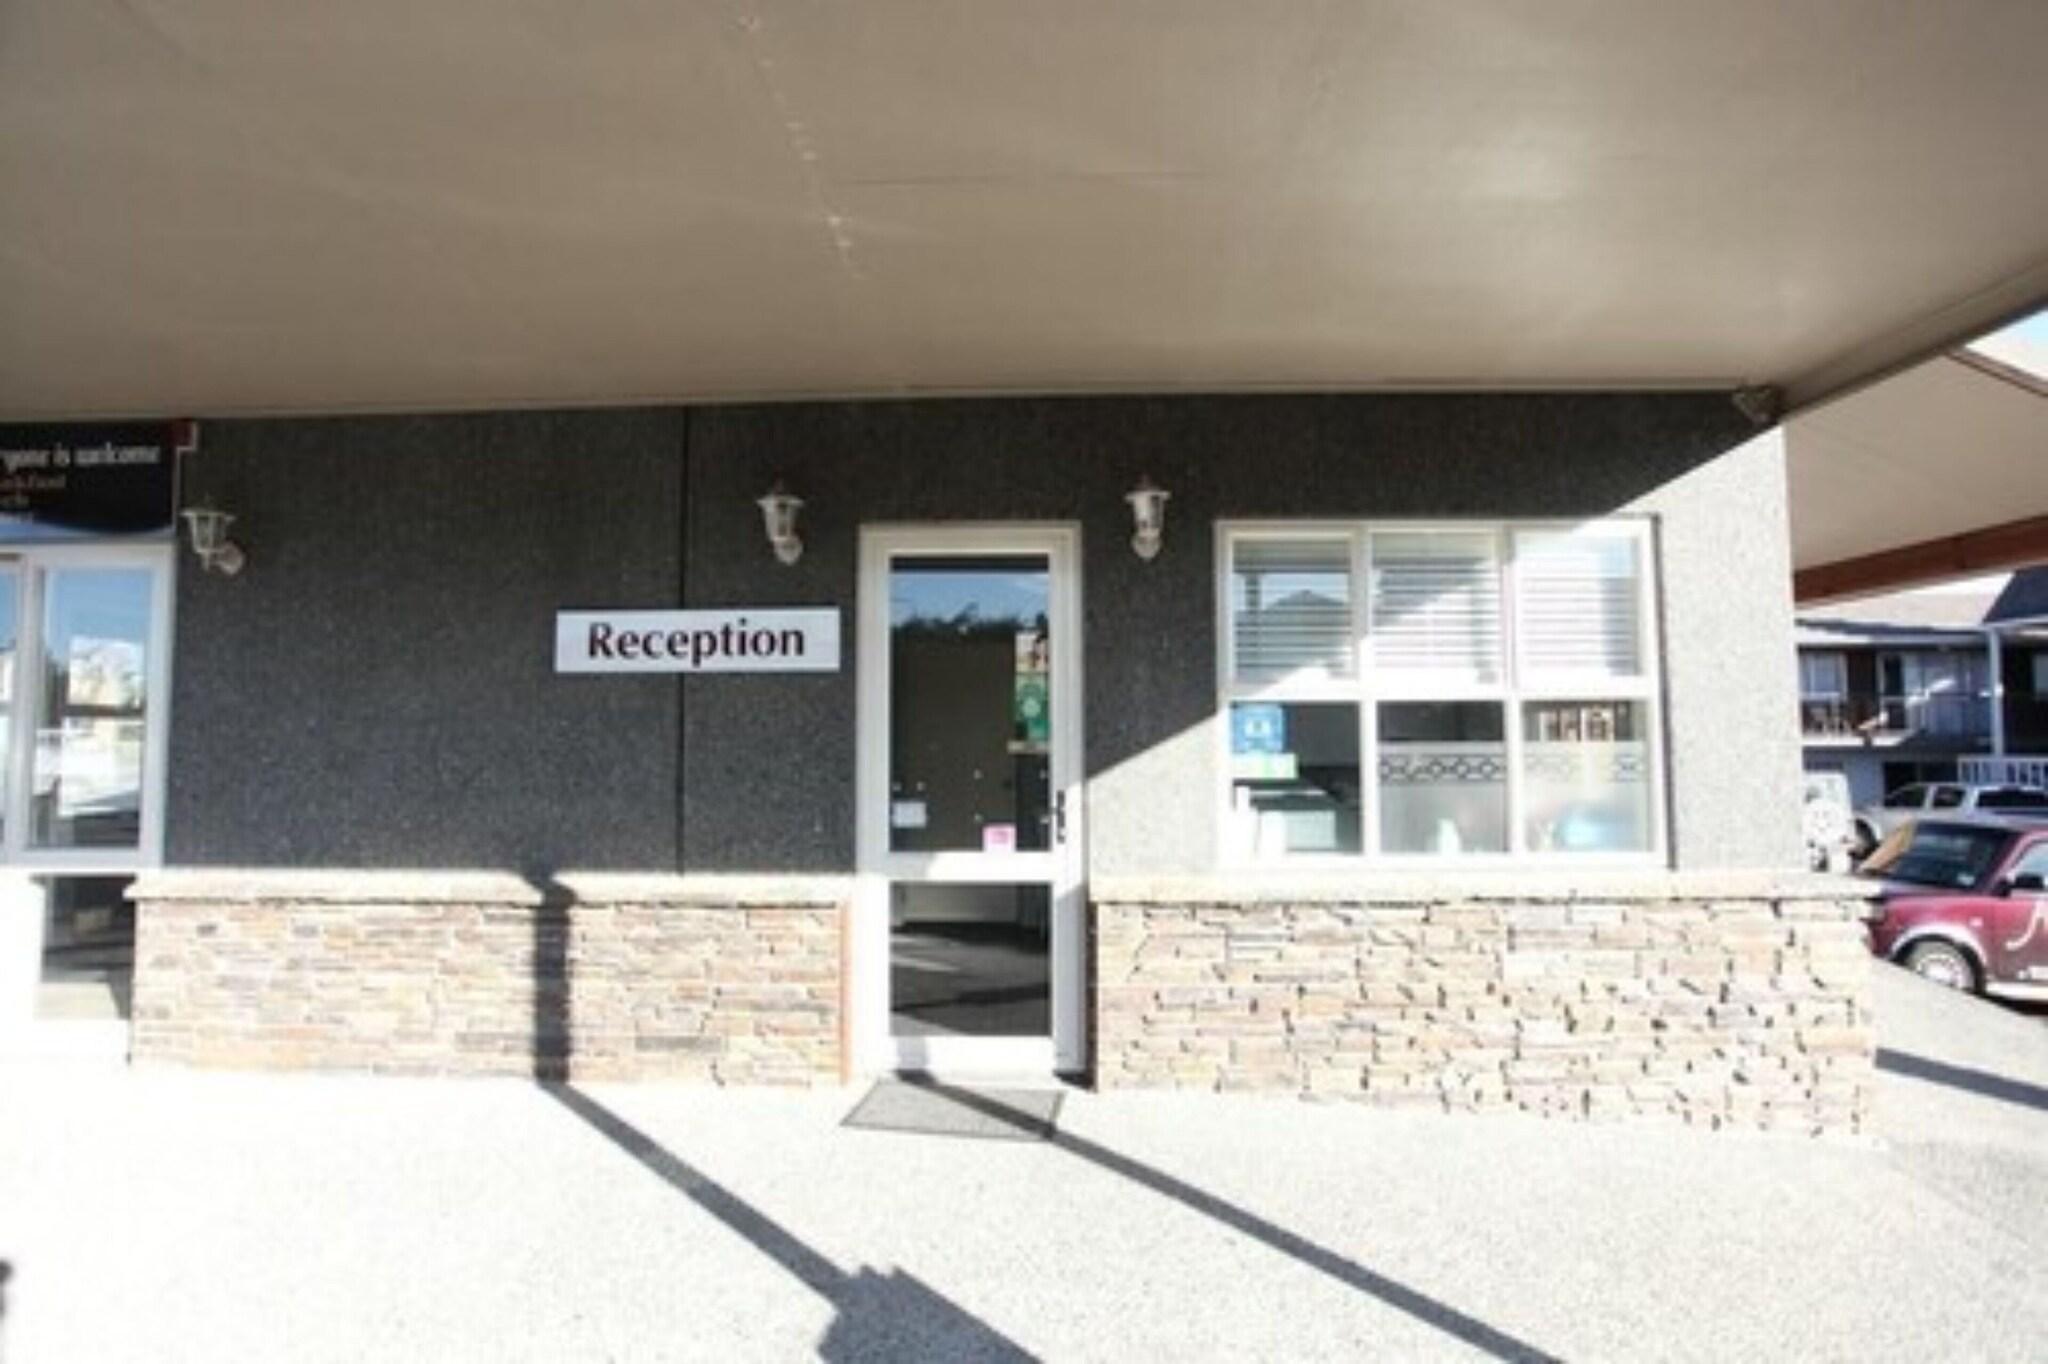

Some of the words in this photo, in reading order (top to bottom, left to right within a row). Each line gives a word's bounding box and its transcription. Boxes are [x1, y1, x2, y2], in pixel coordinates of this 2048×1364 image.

[53, 442, 70, 467] is
[75, 441, 160, 465] welcome
[588, 618, 805, 667] Reception
